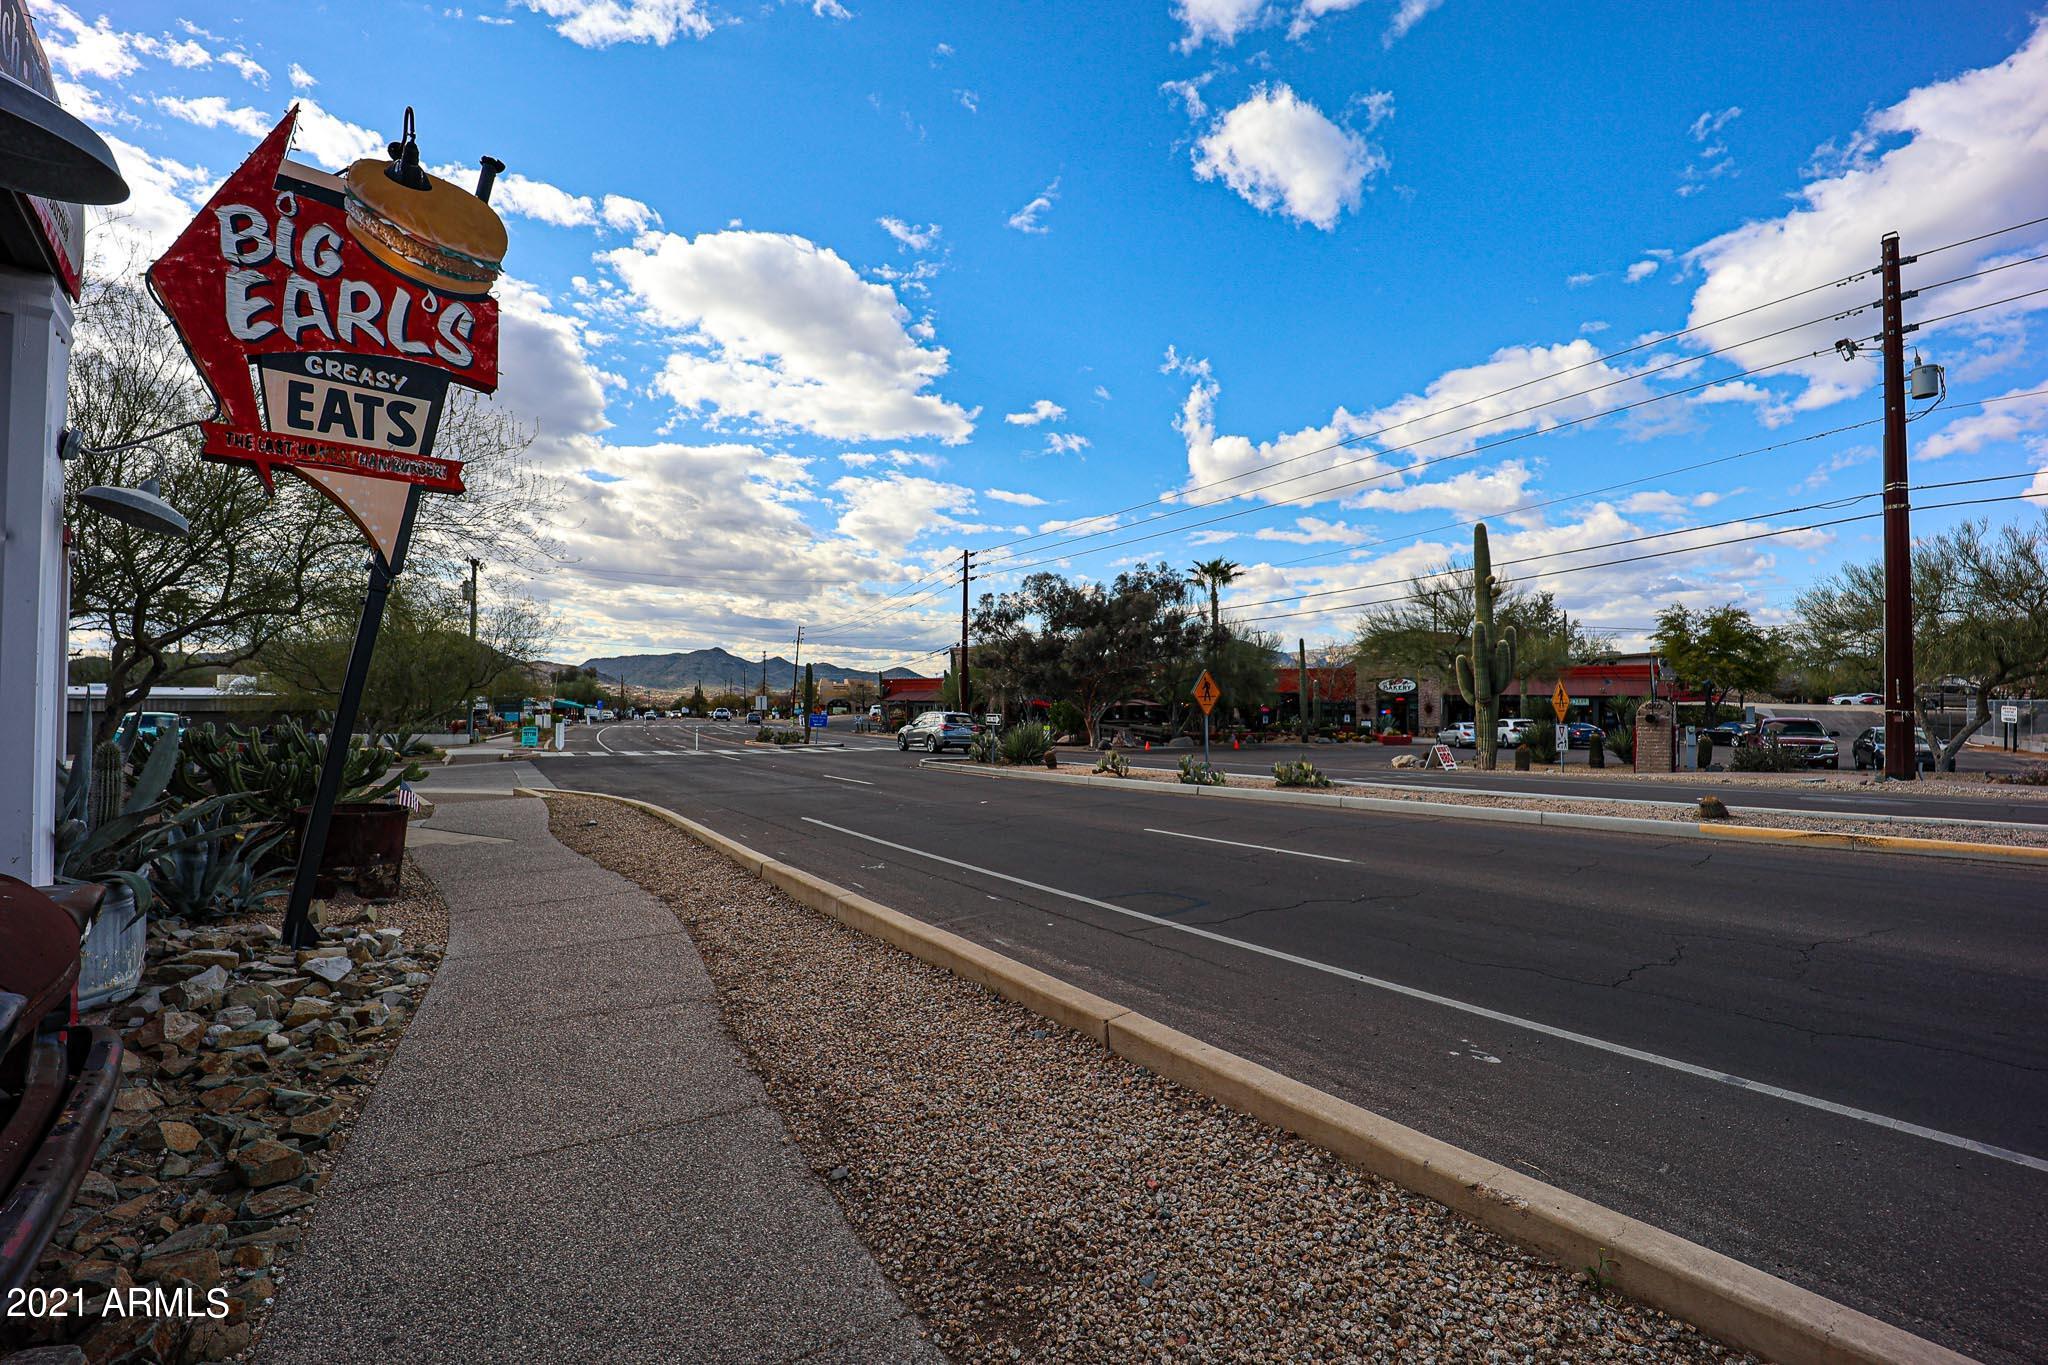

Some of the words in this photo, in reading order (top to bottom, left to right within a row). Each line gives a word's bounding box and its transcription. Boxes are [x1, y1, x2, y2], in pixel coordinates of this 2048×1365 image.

[226, 269, 475, 368] EARL'S
[305, 355, 408, 392] GREASY
[287, 379, 417, 447] EATS
[226, 431, 254, 451] THE
[258, 436, 293, 457] LAST
